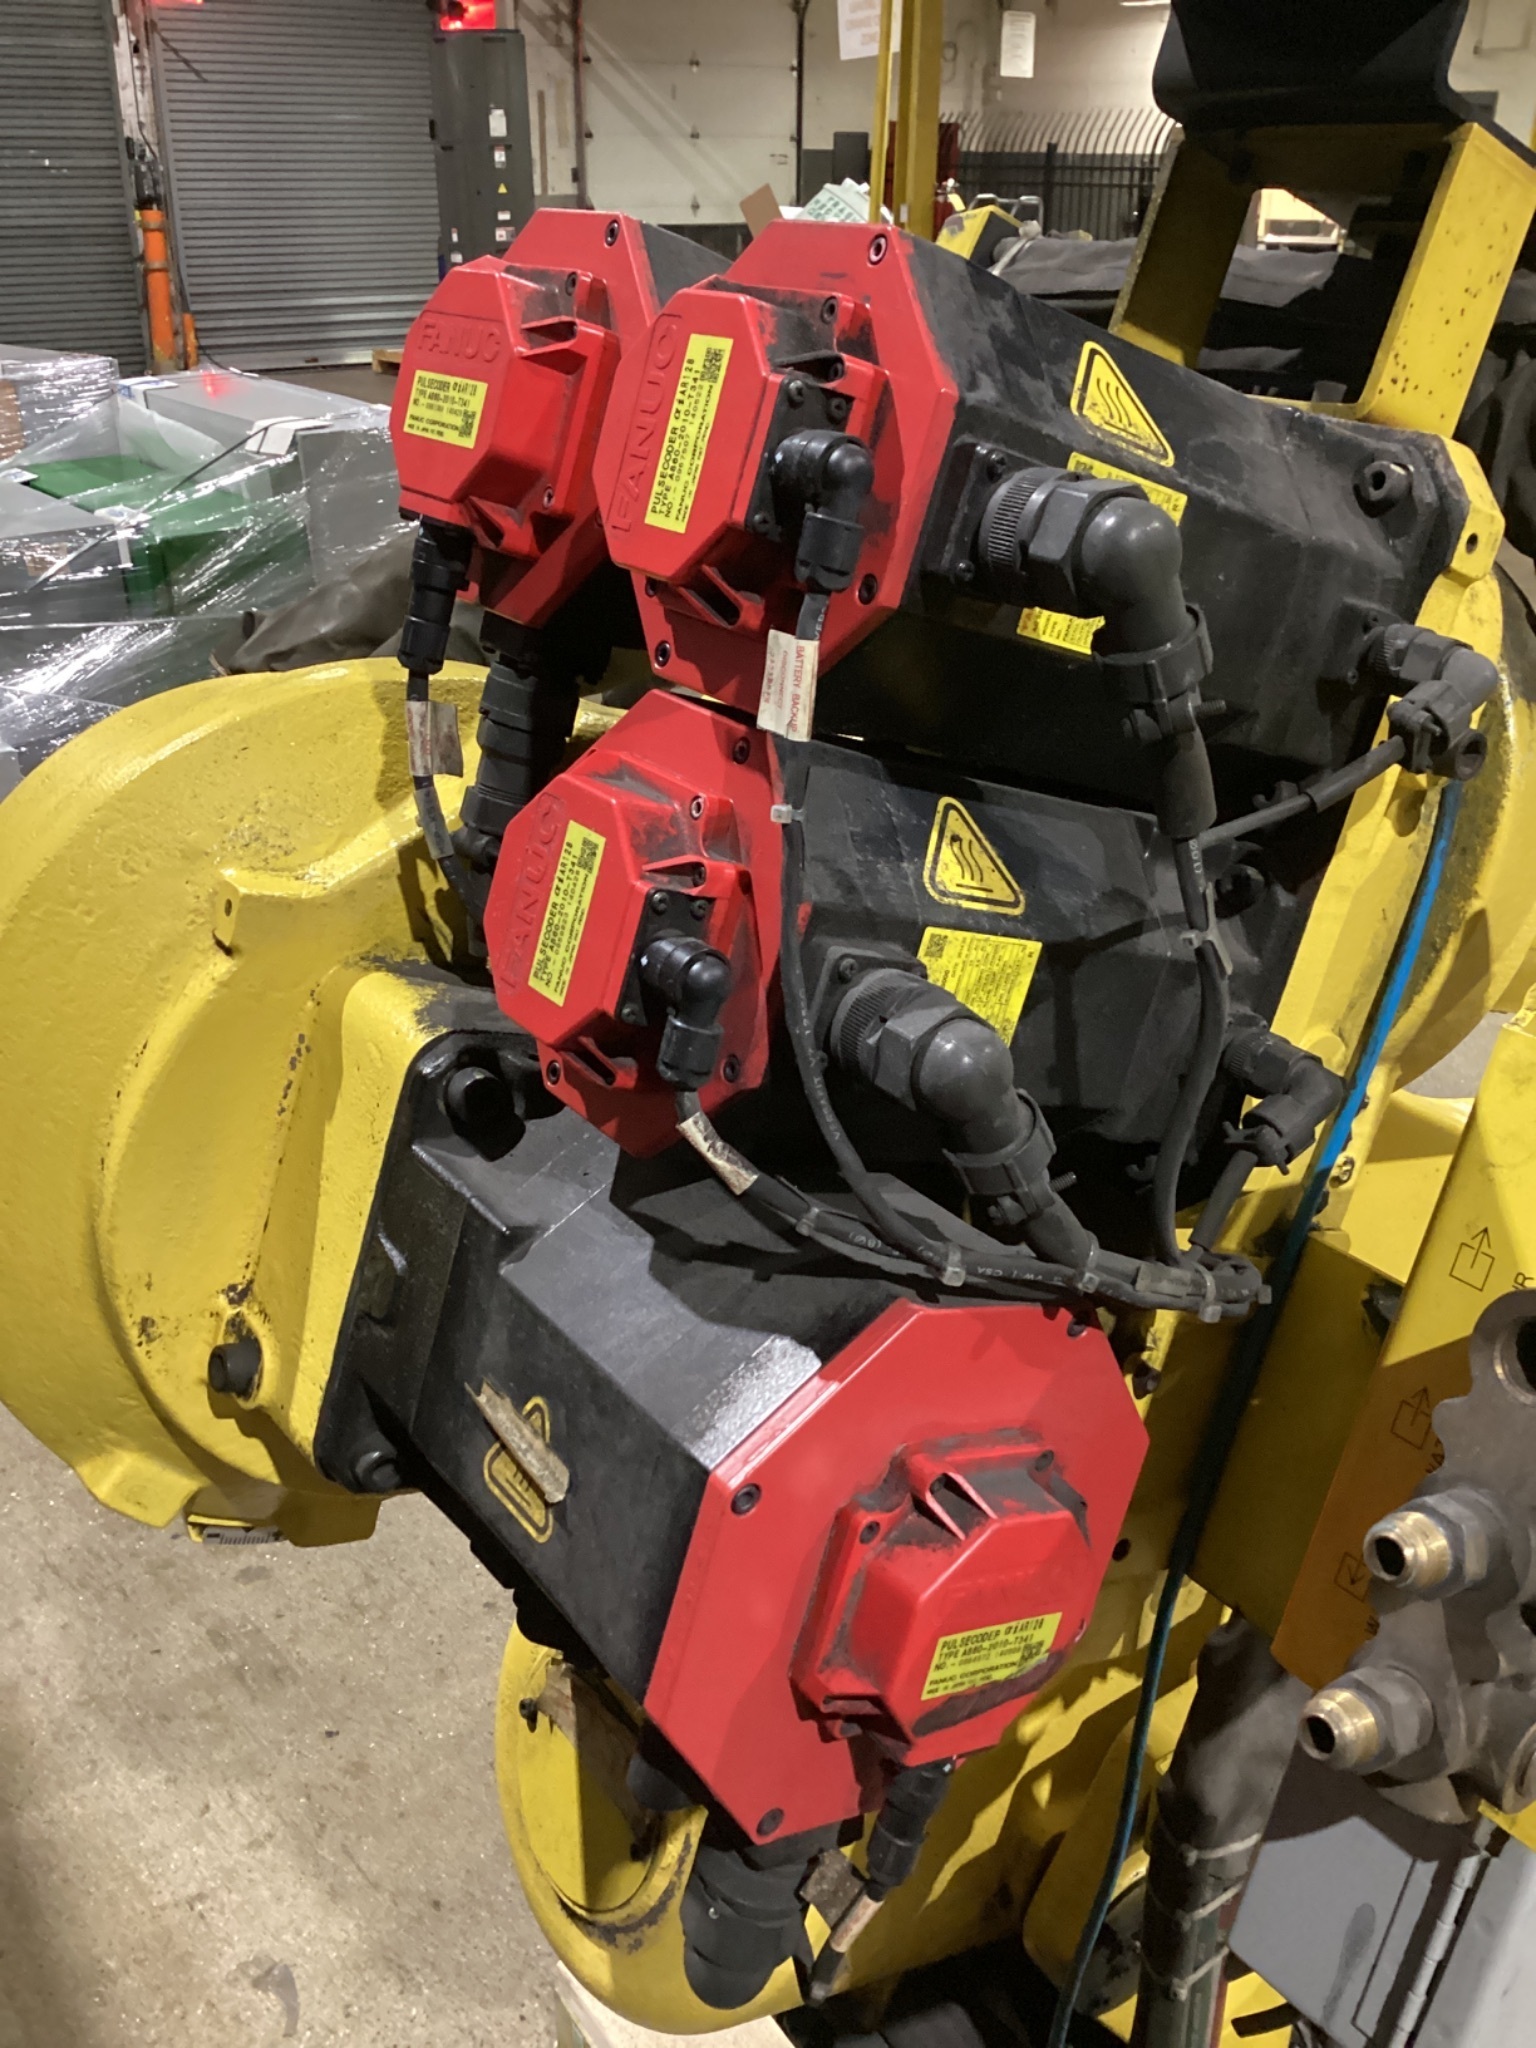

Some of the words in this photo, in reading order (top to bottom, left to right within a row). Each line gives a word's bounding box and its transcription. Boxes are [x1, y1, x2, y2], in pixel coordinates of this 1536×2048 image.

[418, 323, 501, 363] FANUC
[416, 388, 427, 399] TYPE
[418, 376, 450, 392] PULSECODER
[612, 324, 676, 532] FANUC
[651, 426, 678, 514] PULSECODER
[676, 480, 689, 522] FANUC
[687, 385, 713, 476] CORPORATION
[658, 484, 671, 514] TYPE
[793, 645, 805, 688] BATTERY
[790, 694, 802, 732] BACKUP
[500, 803, 564, 989] FANUC
[533, 901, 558, 980] PULSECODER
[554, 955, 568, 993] FANUC
[565, 874, 589, 952] CORPORATION
[540, 956, 552, 982] TYPE
[939, 1648, 959, 1664] TYPE
[941, 1630, 1000, 1650] PULSECODER
